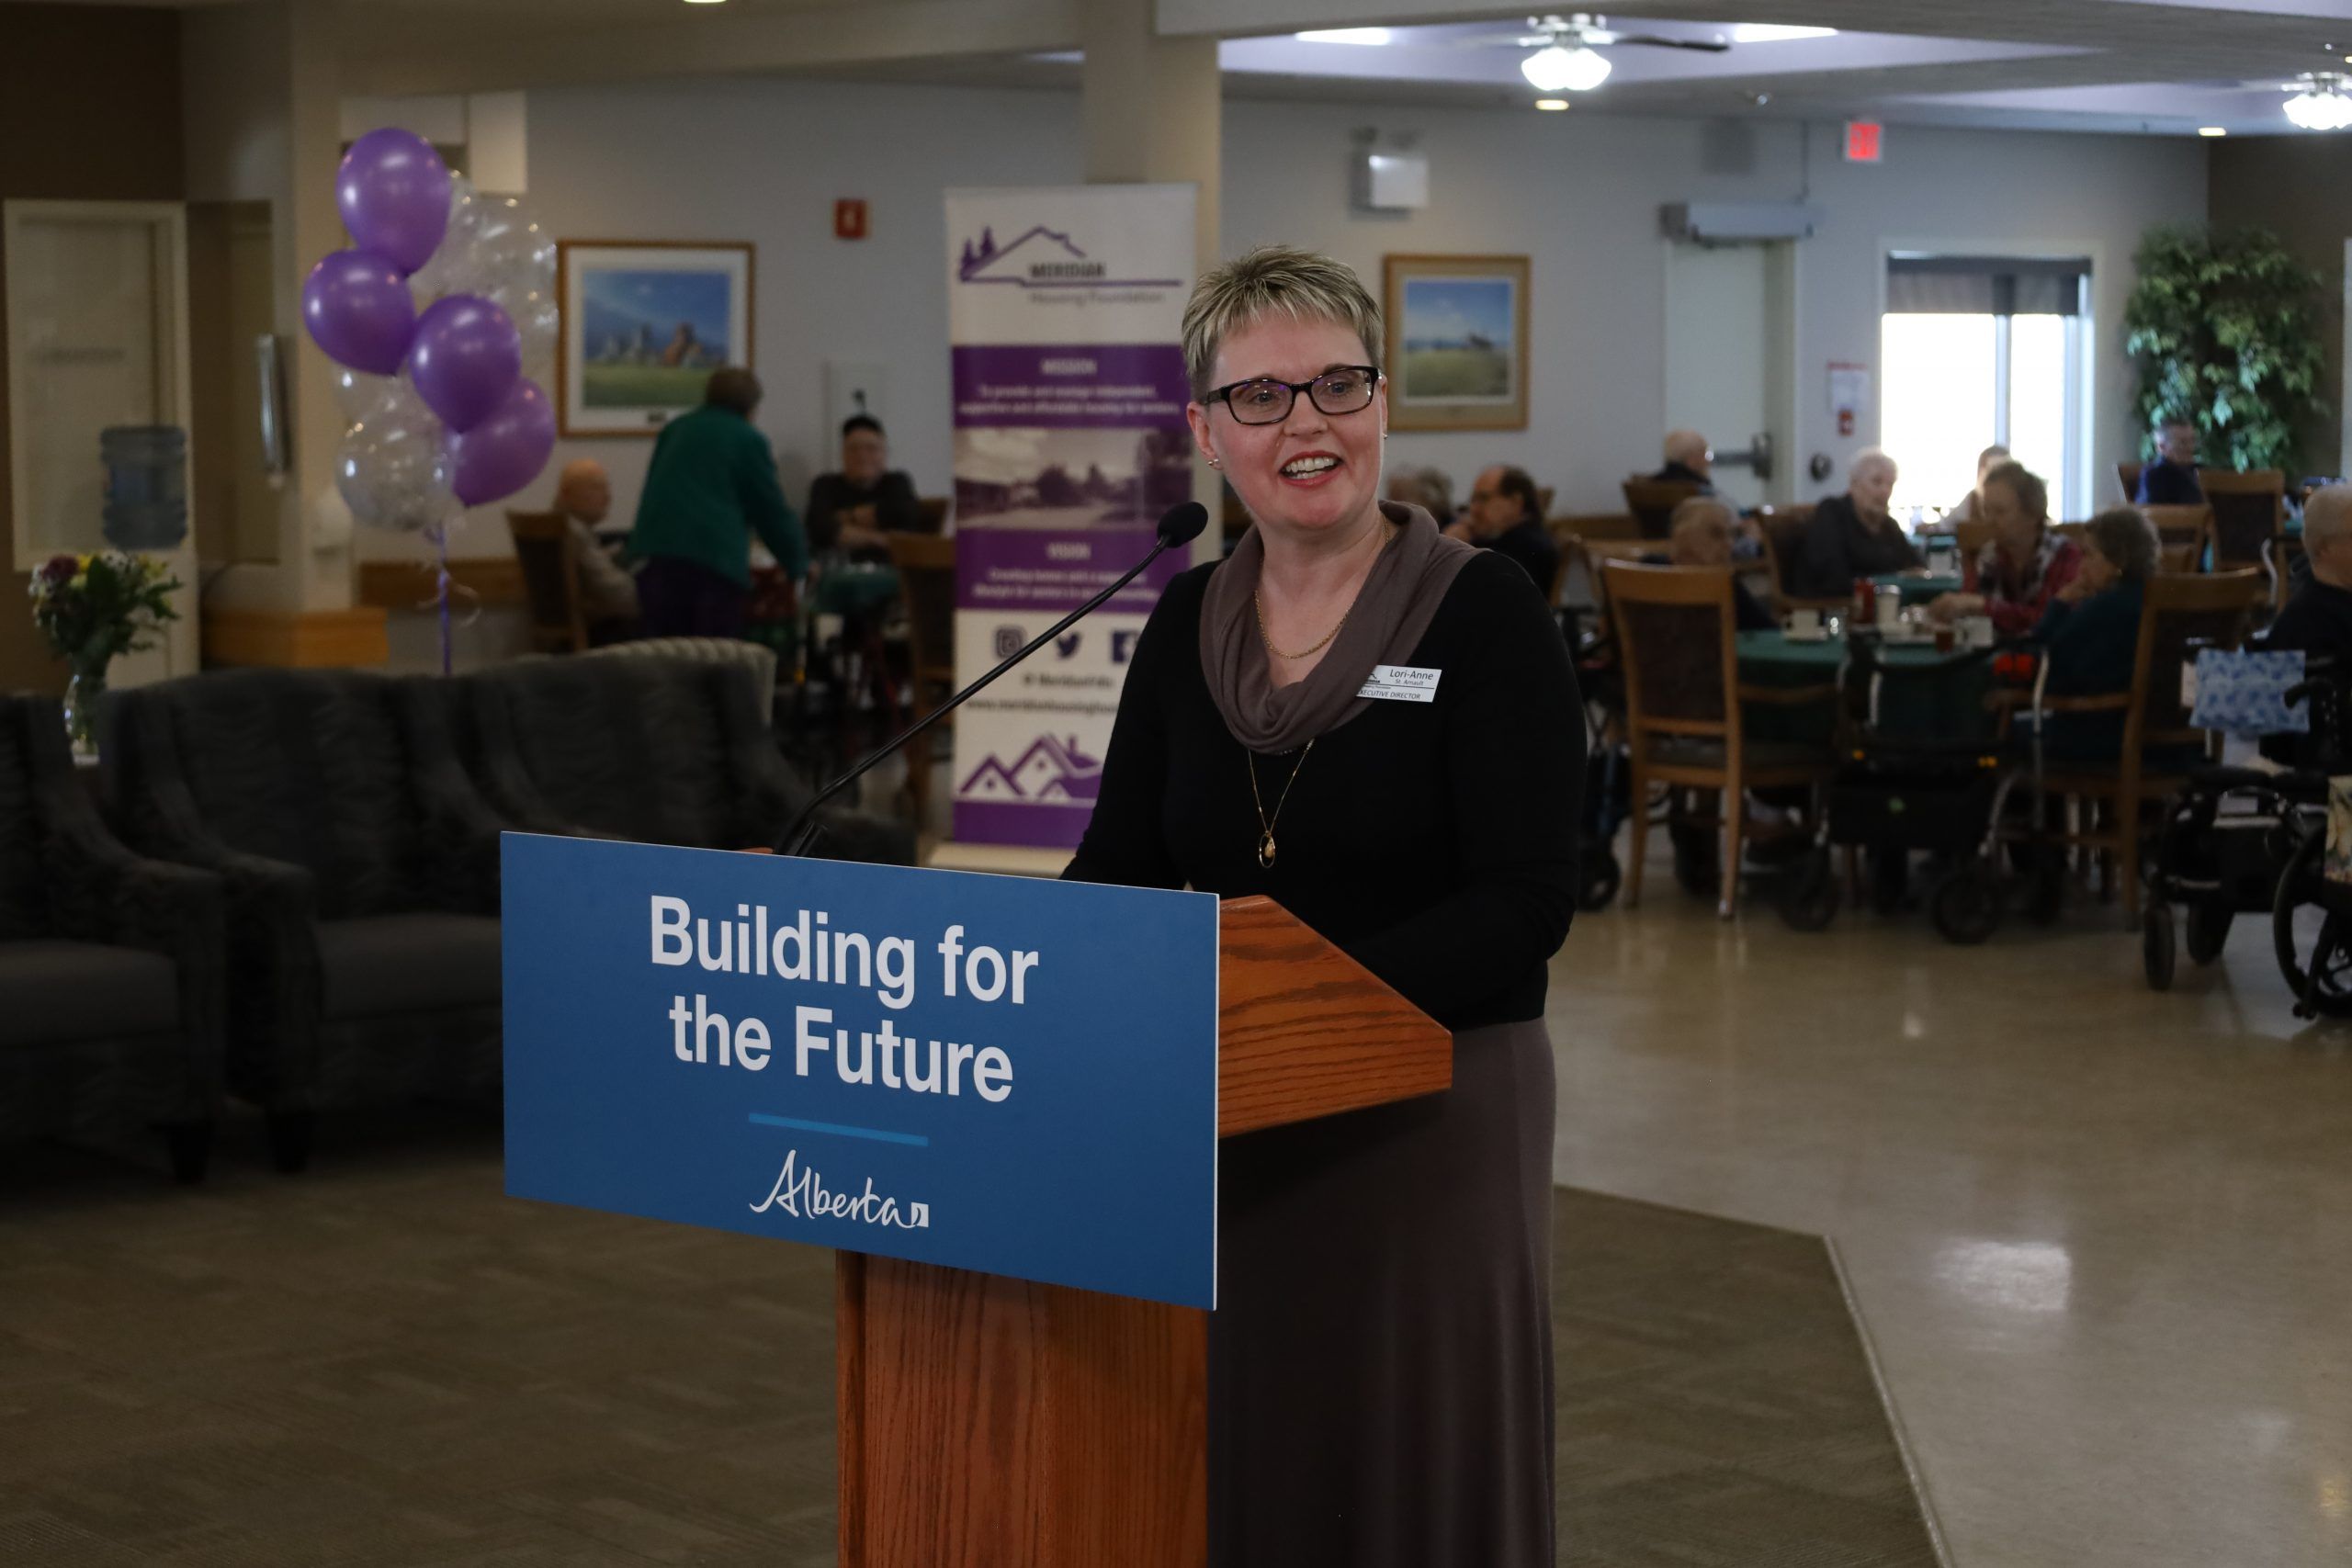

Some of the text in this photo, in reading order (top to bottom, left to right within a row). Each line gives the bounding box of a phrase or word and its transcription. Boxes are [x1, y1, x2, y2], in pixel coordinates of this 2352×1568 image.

[1028, 263, 1106, 277] MERIDIAN
[1389, 669, 1434, 681] Lori-Anne
[650, 894, 1039, 1010] Building for
[668, 993, 1013, 1102] the Future
[749, 1149, 923, 1229] Alberta
